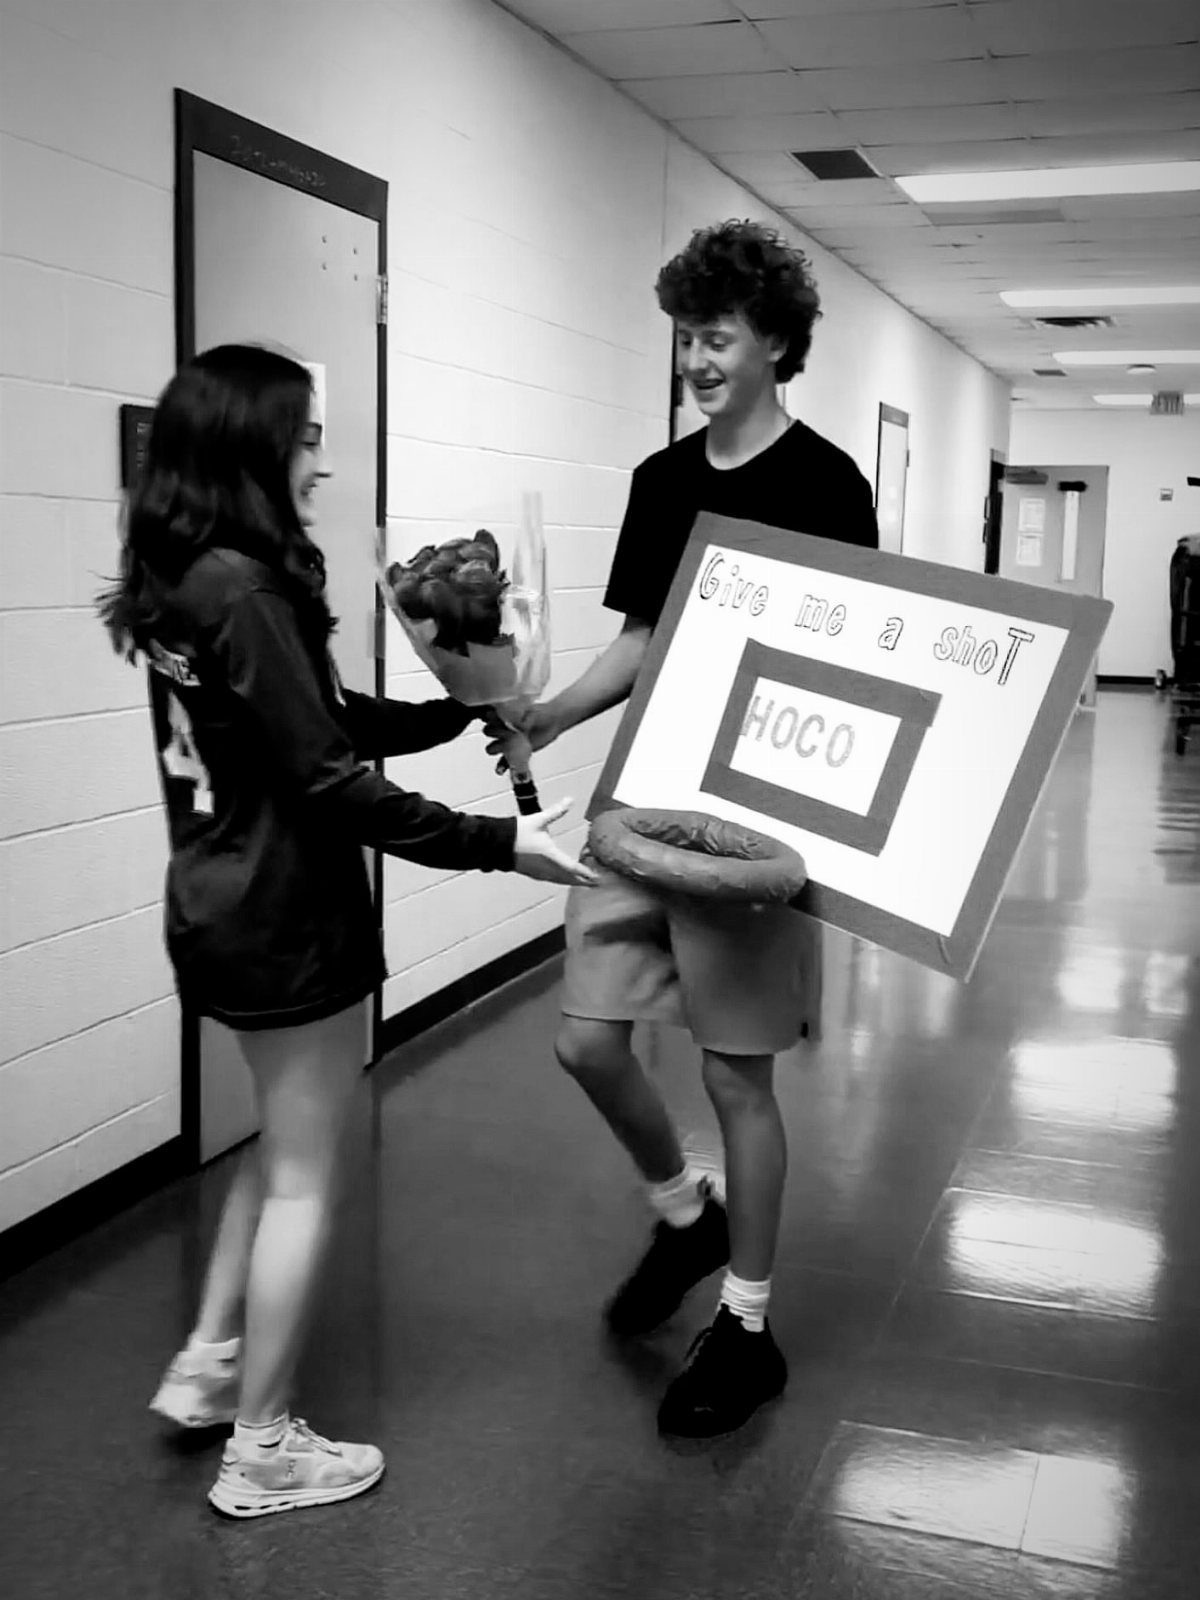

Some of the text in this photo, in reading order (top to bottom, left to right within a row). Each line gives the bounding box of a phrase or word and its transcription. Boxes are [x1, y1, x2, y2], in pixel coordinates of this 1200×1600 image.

[699, 551, 769, 616] Give
[795, 593, 847, 636] me
[878, 616, 905, 650] a
[740, 695, 856, 768] HOCO
